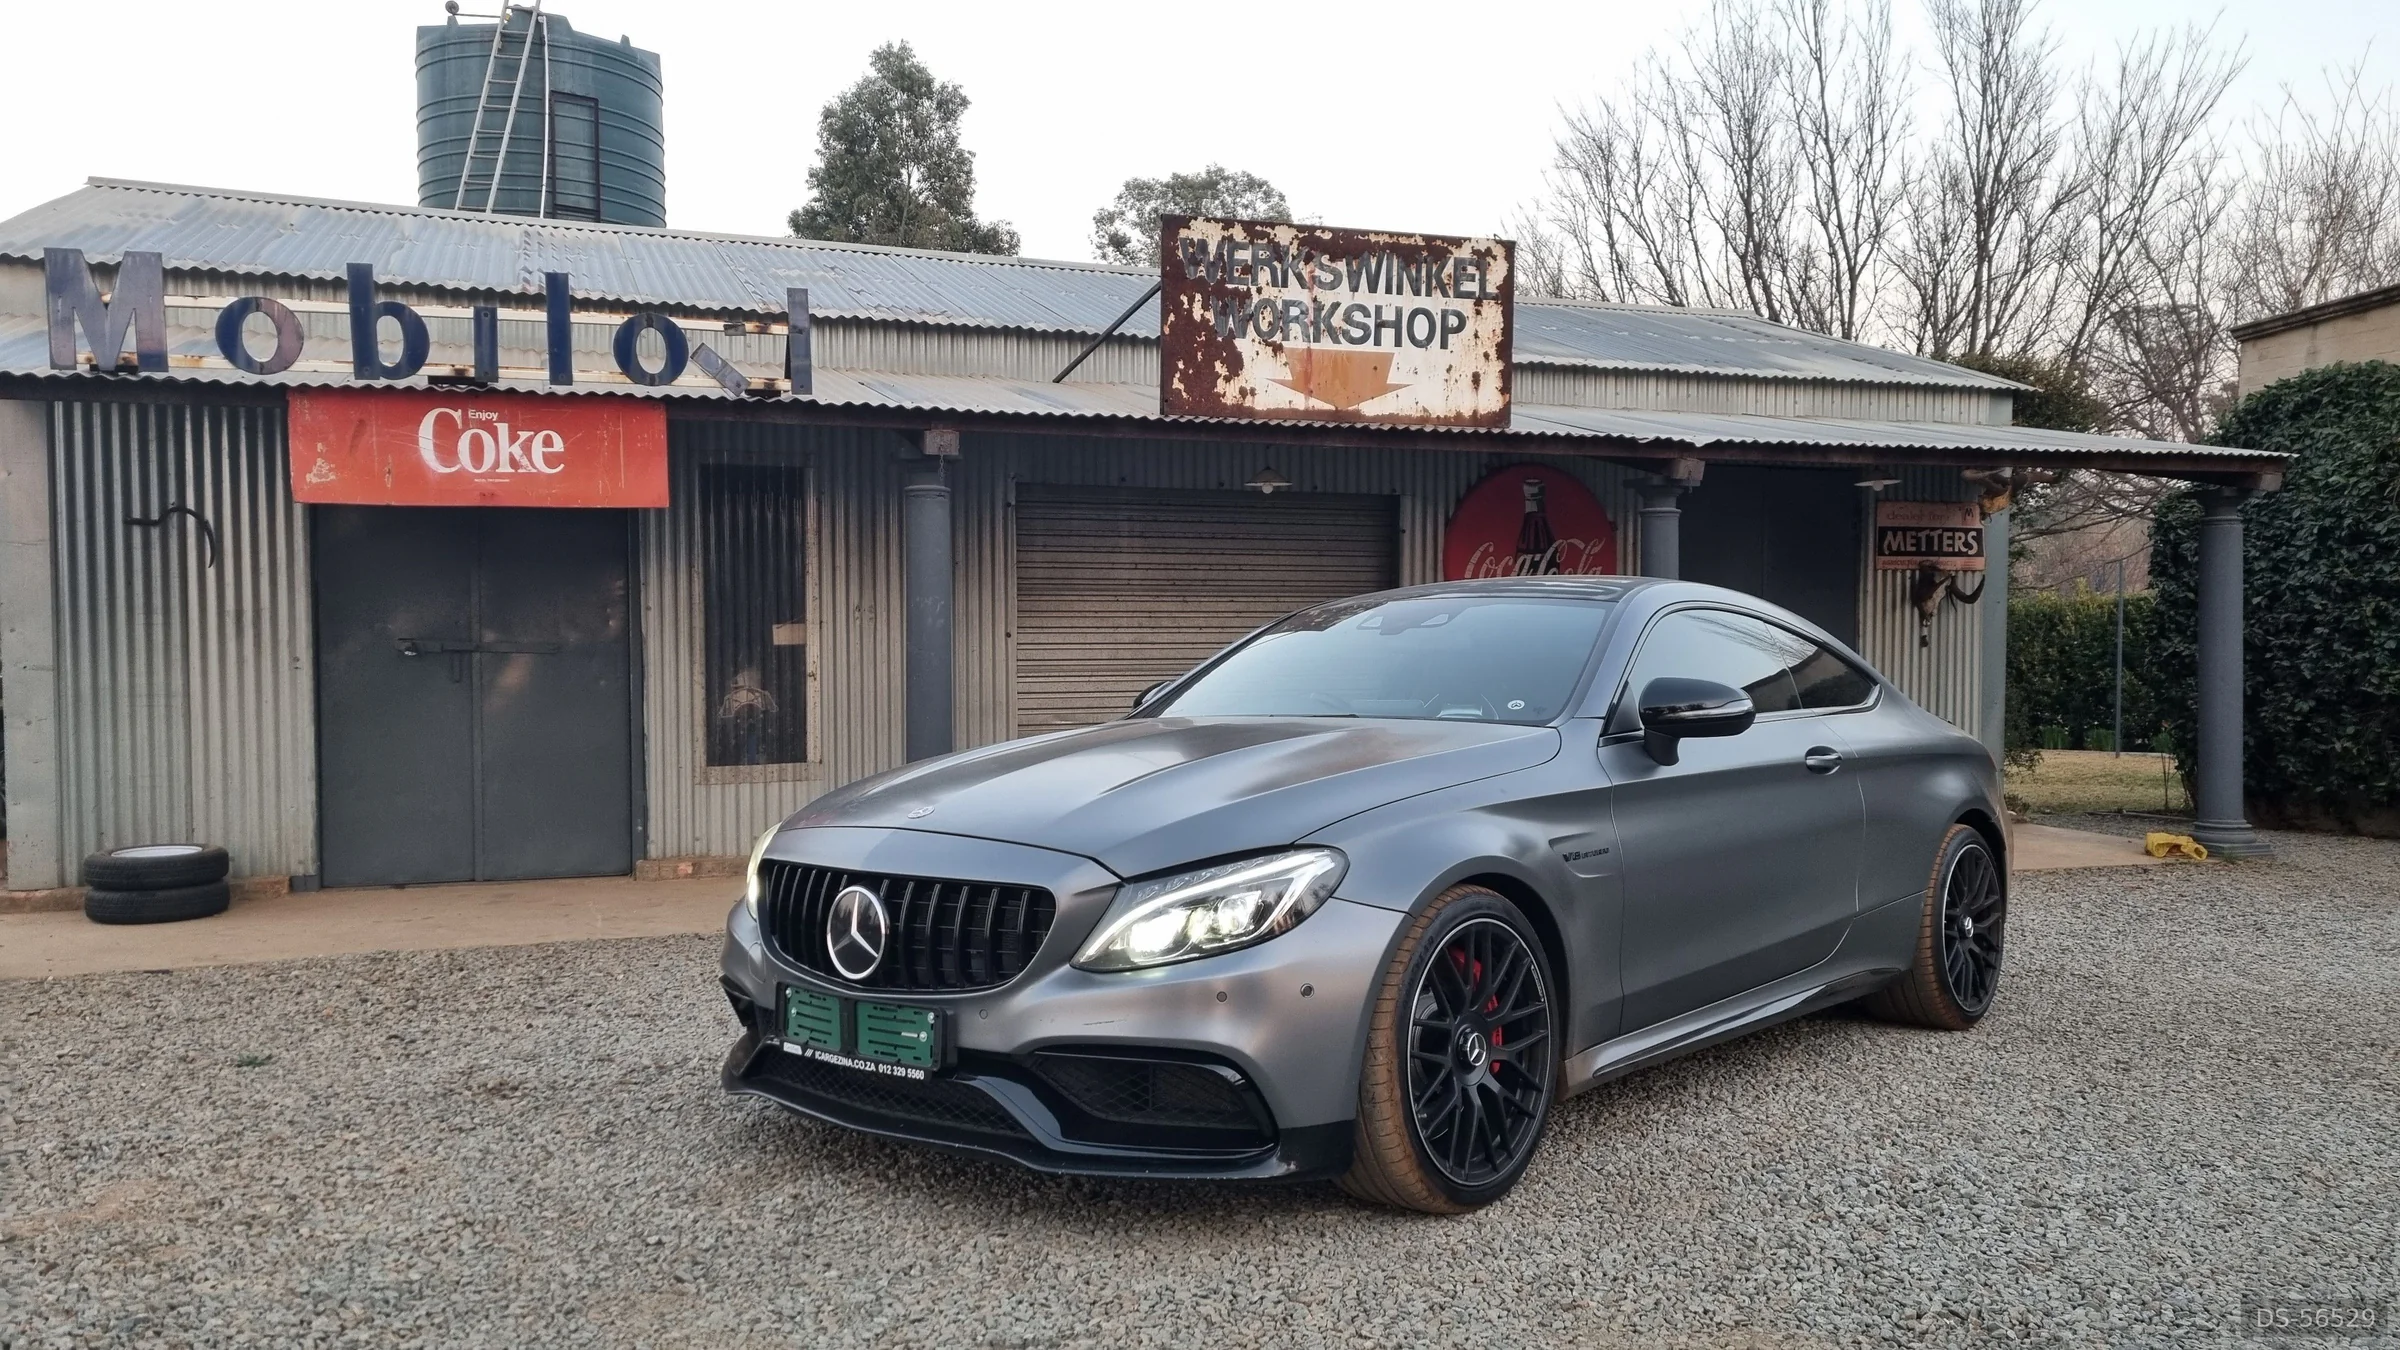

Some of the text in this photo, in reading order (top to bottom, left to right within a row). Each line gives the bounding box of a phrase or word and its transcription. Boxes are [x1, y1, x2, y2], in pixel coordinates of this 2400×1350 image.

[1211, 296, 1467, 350] WORKSHOP
[468, 409, 499, 421] Enjoy
[418, 407, 565, 474] Coke
[1883, 529, 1978, 555] METTERS
[878, 1063, 892, 1075] 012
[893, 1065, 906, 1077] 329
[907, 1068, 925, 1080] 5560
